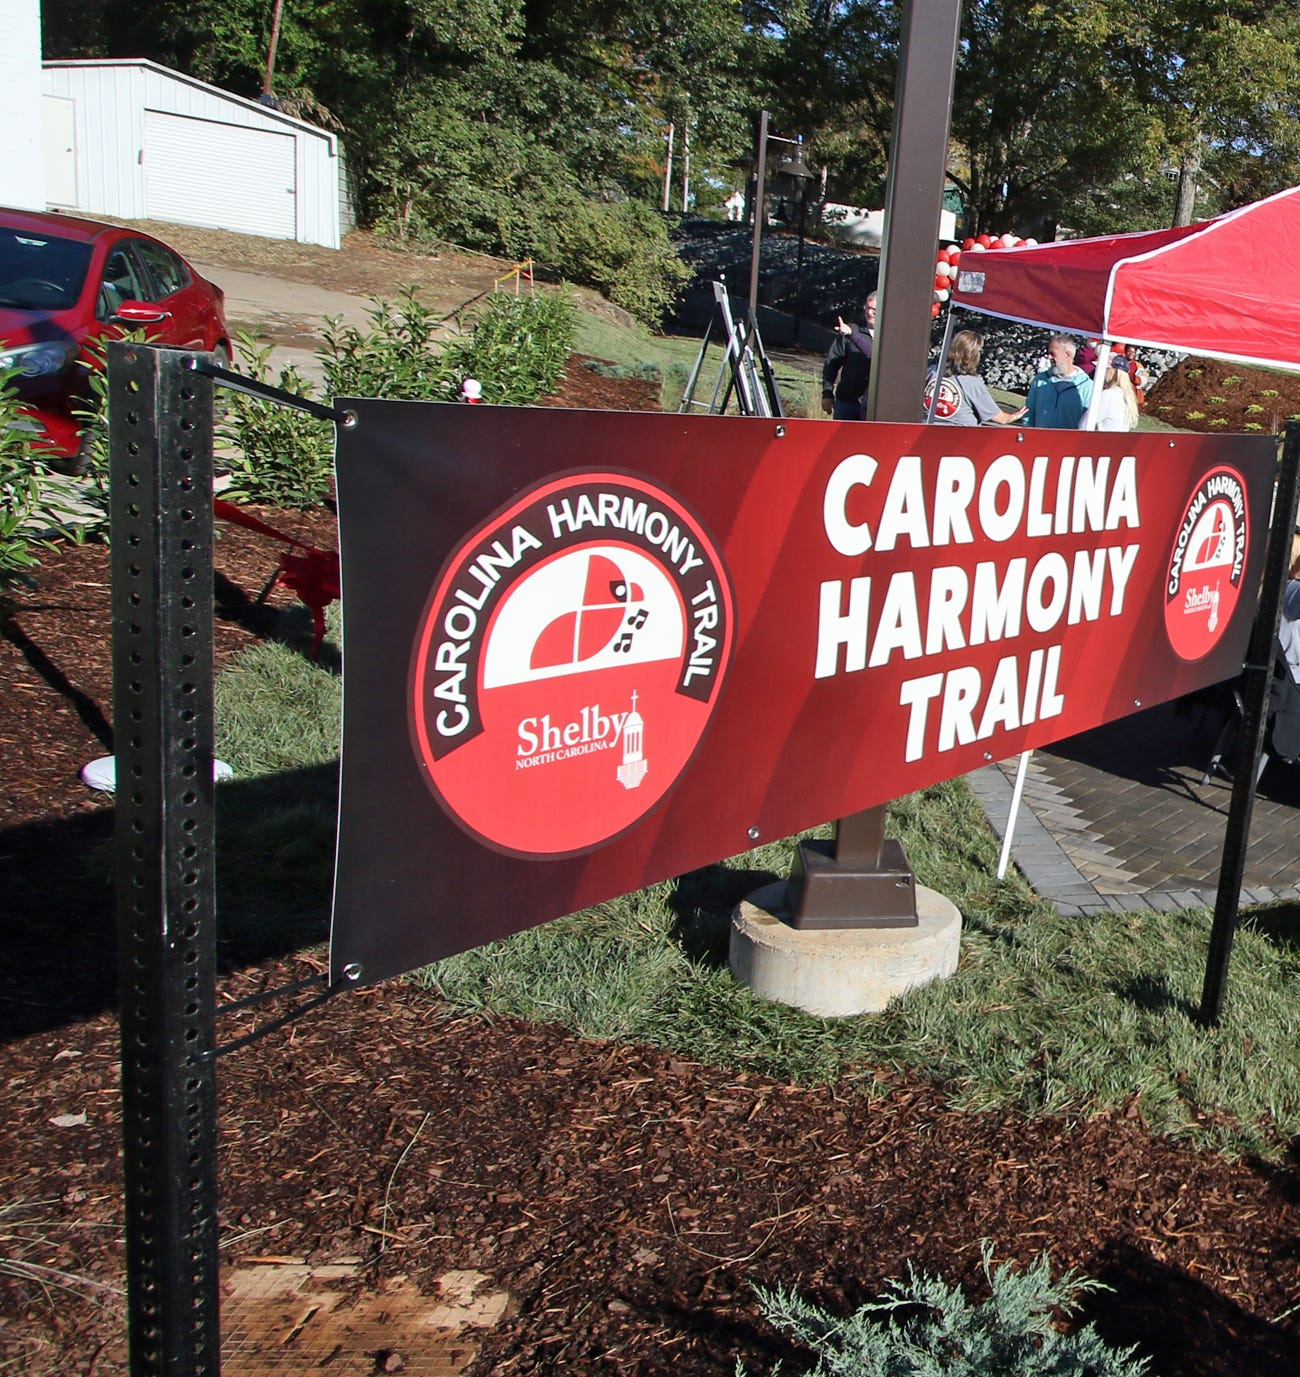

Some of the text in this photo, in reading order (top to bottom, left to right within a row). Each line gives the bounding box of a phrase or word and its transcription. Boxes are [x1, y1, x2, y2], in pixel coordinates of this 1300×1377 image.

[823, 453, 1140, 557] CAROLINA
[1168, 490, 1207, 595] CAROLINA
[1206, 475, 1244, 519] HARMONY
[1231, 521, 1245, 580] TRAIL
[433, 492, 718, 738] CAROLINA HARMONY TRAIL
[814, 543, 1140, 680] HARMONY
[1184, 585, 1213, 609] Shelby
[515, 740, 608, 770] NORTH CAROLINA
[517, 704, 629, 757] Shelby
[899, 644, 1065, 763] TRAIL
